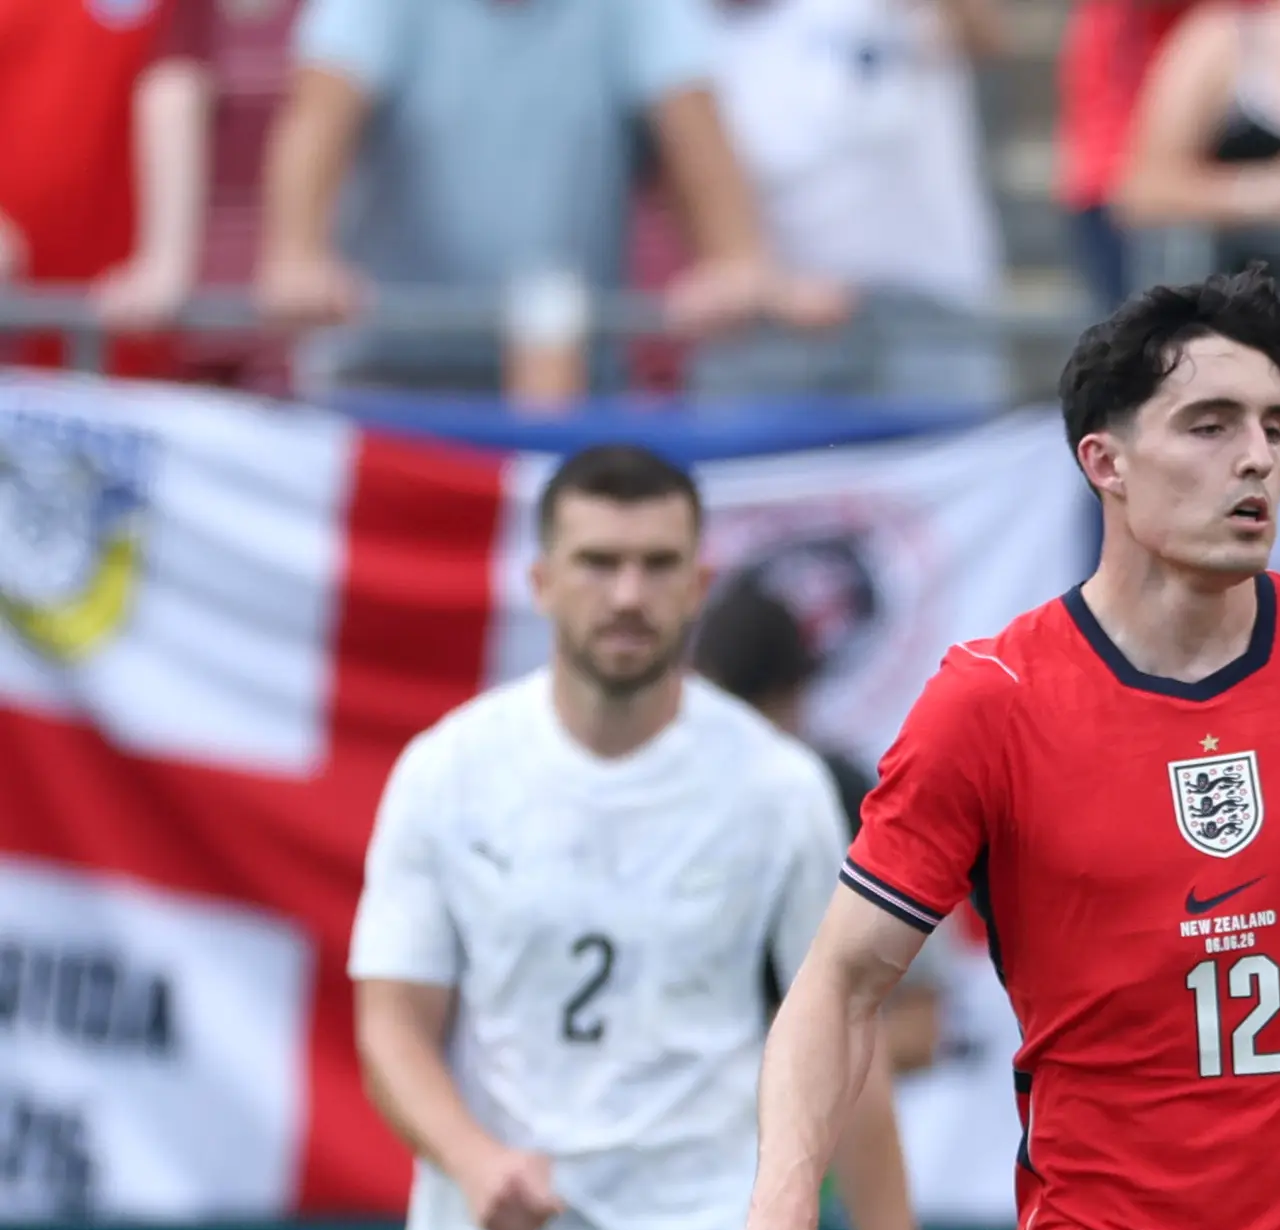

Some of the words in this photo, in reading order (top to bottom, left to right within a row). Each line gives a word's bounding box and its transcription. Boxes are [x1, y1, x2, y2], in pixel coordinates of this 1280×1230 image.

[1180, 918, 1212, 937] NEW
[1213, 910, 1276, 933] ZEALAND
[1204, 932, 1255, 954] 06.06.26
[561, 931, 616, 1044] 2
